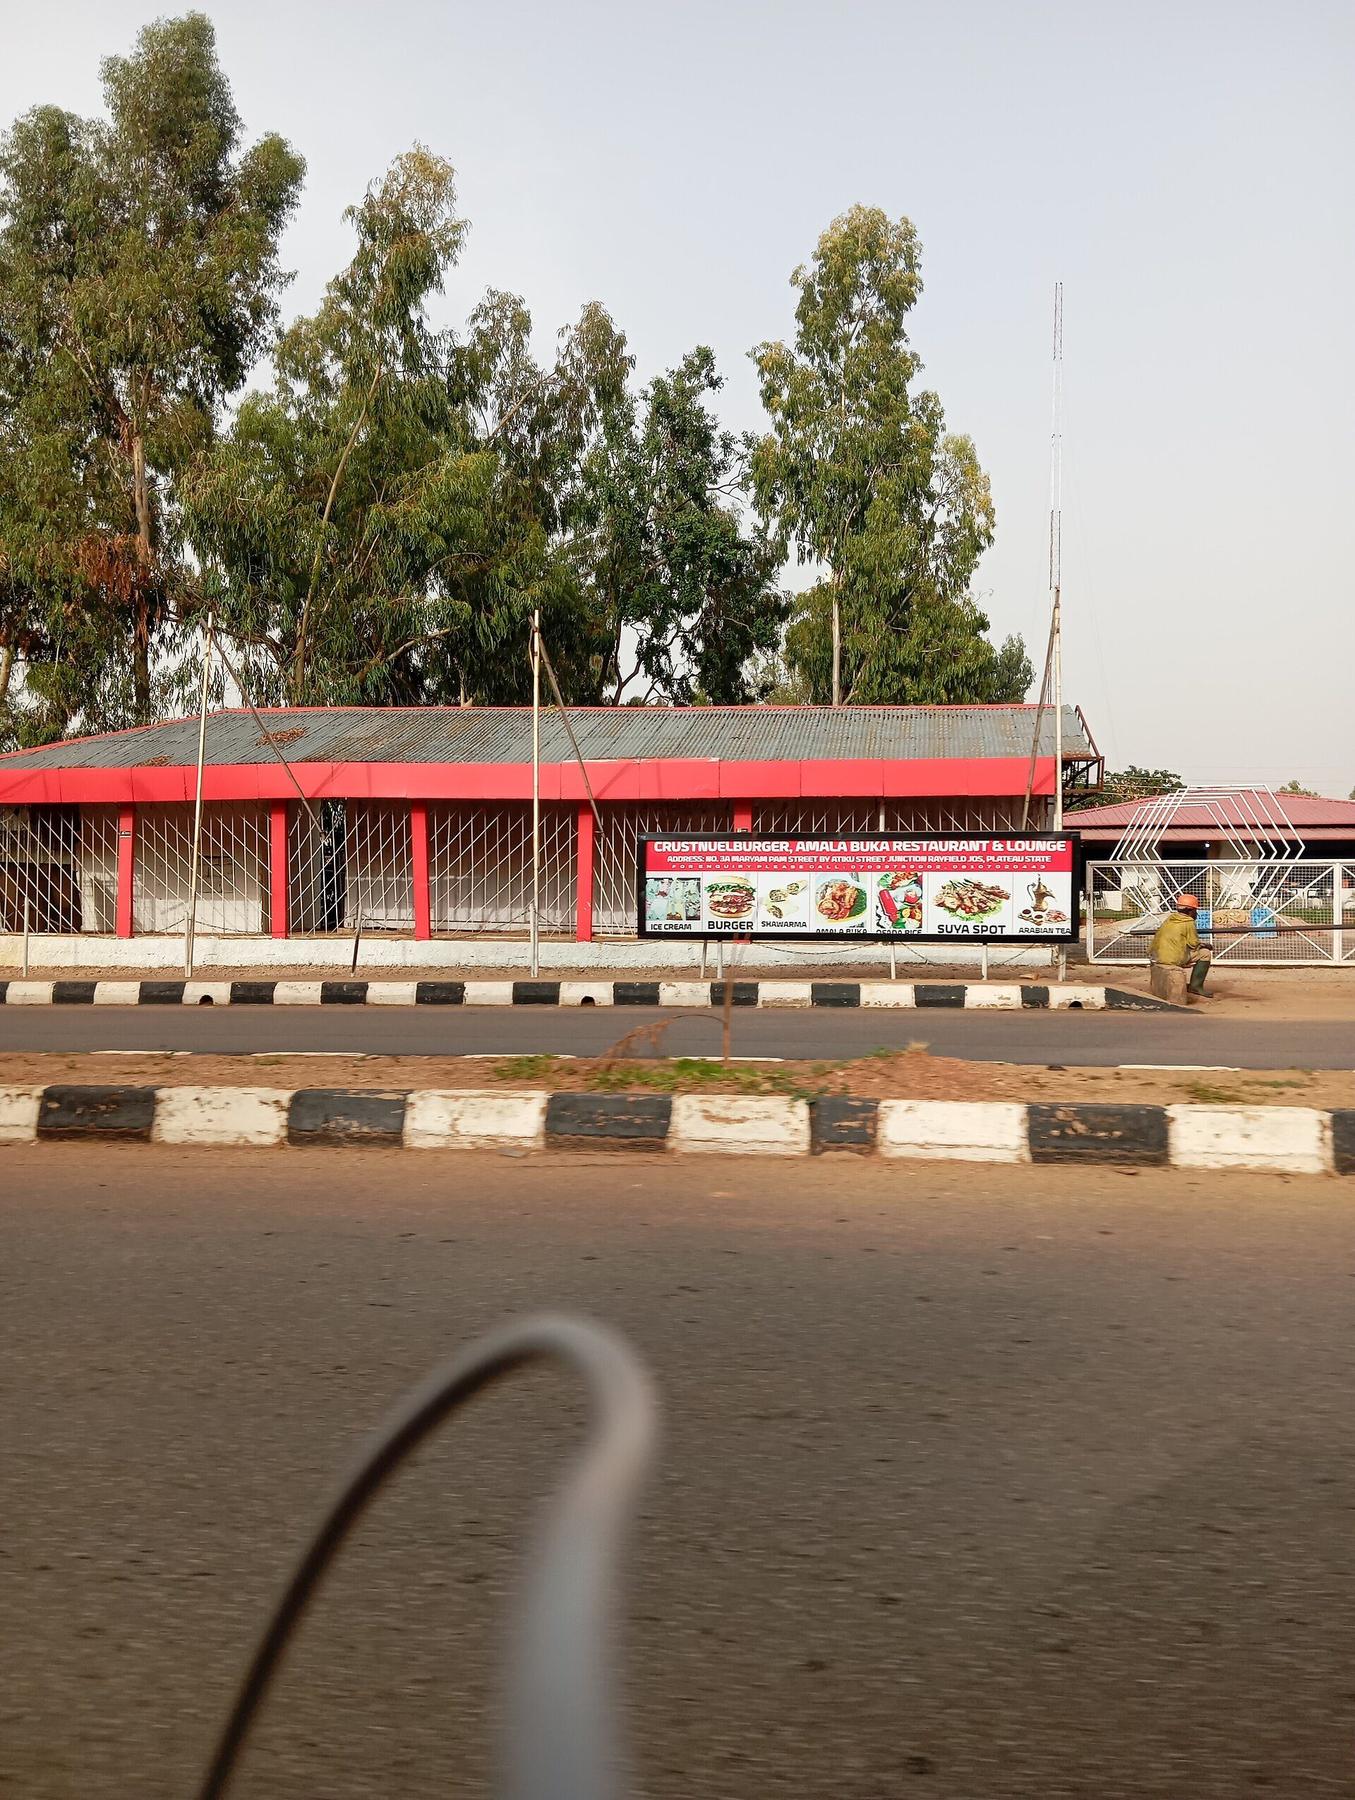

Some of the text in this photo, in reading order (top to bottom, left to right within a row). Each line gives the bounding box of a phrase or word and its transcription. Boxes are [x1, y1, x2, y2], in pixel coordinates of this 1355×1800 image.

[654, 841, 1067, 854] CRUSTNUELBURGER, AMALA BUKA RESTAURANT & LOUNGE
[968, 855, 985, 863] JOS,
[708, 920, 754, 930] BURGER
[937, 924, 1006, 934] SUYA SPOT
